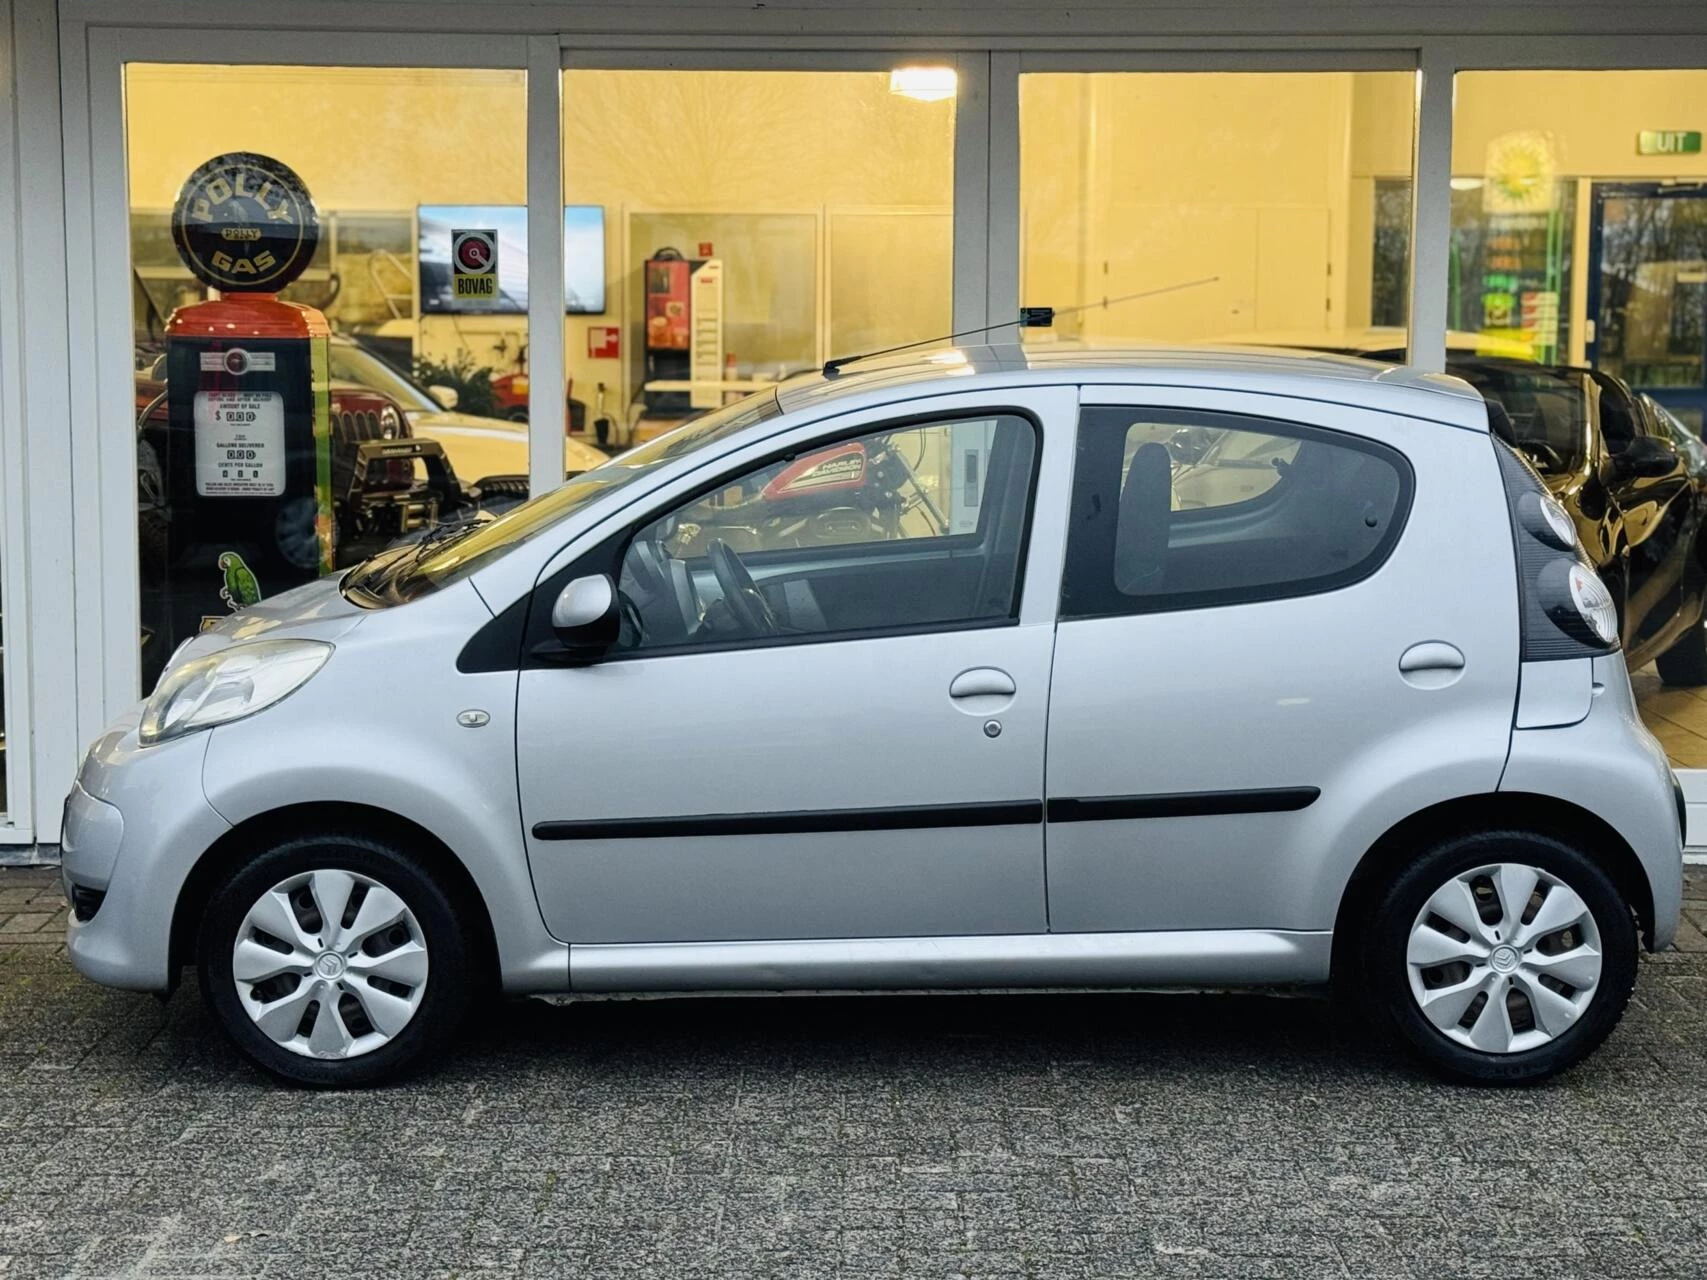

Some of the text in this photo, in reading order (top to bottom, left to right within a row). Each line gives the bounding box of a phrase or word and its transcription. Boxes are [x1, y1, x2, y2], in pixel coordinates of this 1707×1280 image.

[1656, 132, 1687, 152] UIT
[191, 173, 294, 224] POLLY
[211, 250, 277, 275] GAS
[458, 278, 493, 295] BOVAG
